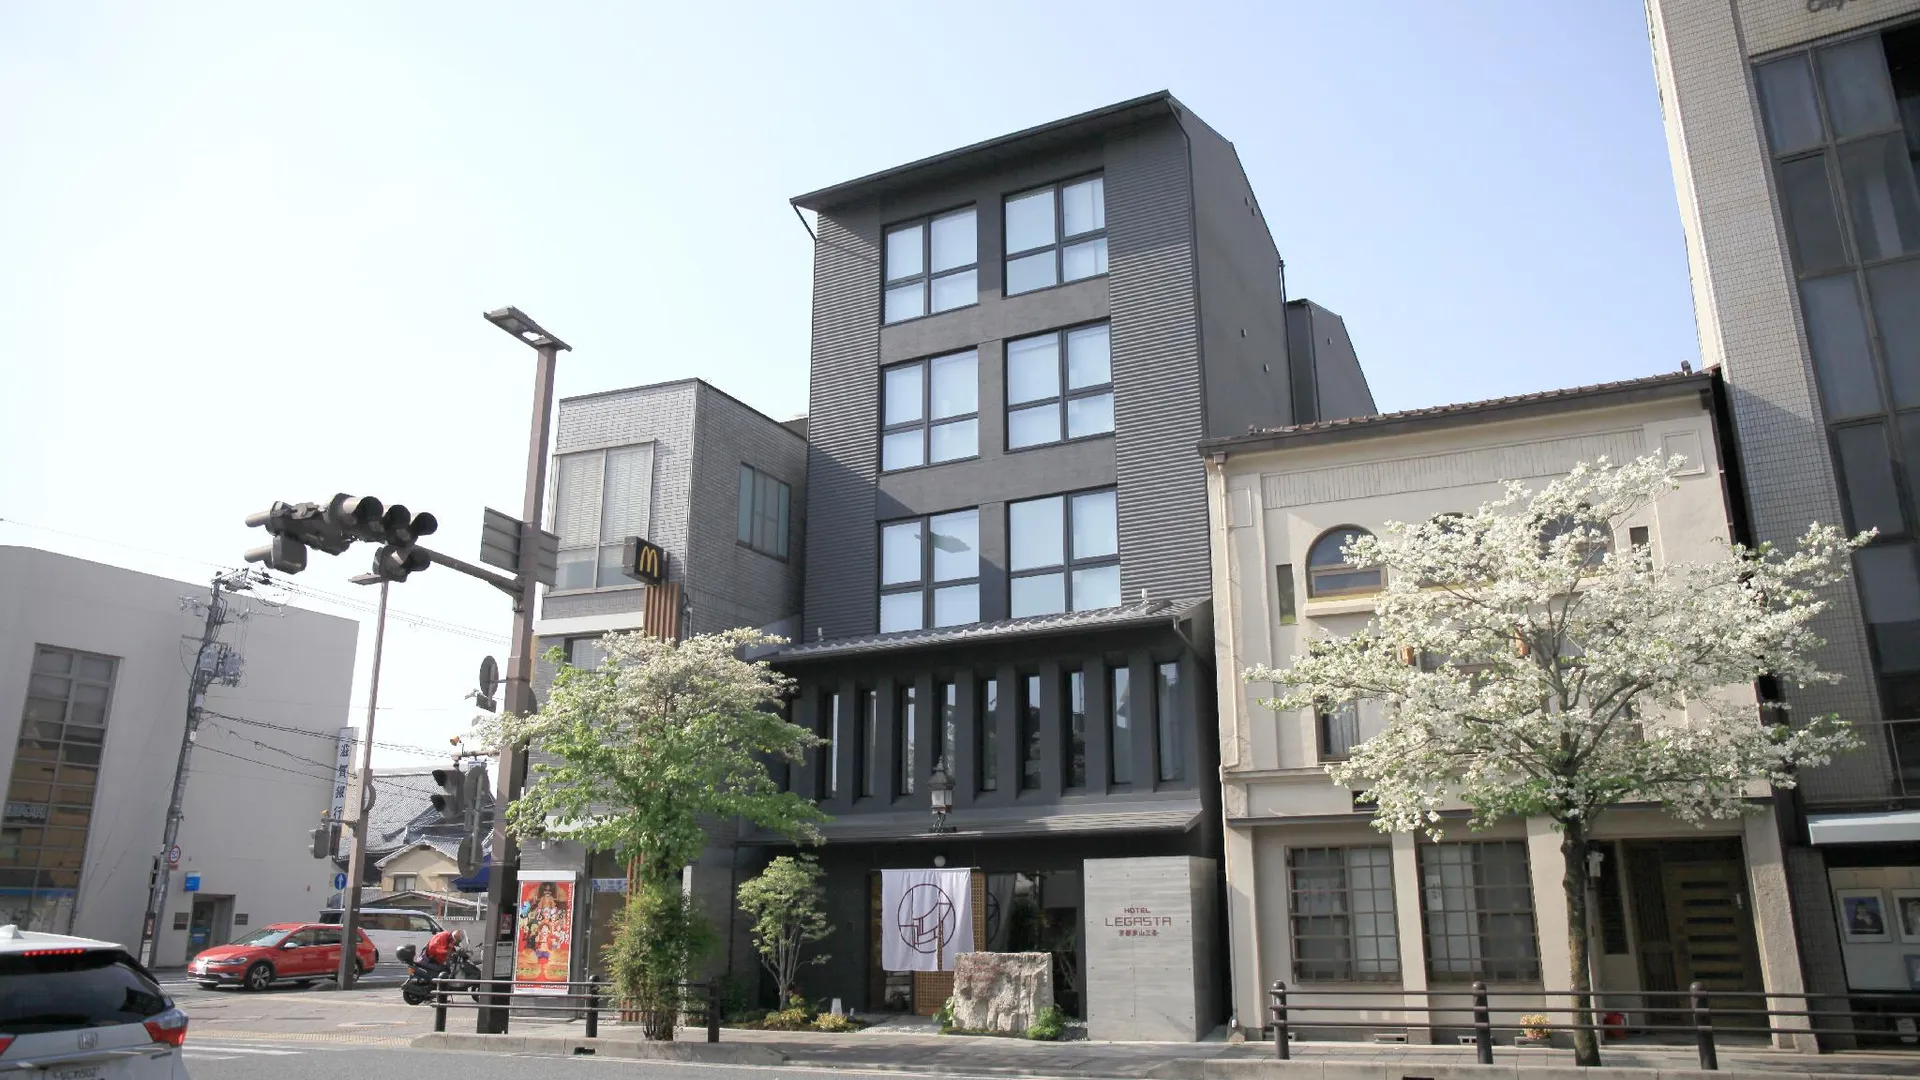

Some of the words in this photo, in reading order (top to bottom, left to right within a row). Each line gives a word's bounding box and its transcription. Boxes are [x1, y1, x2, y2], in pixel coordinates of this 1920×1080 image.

[333, 744, 350, 820] 滋賀銀行
[1105, 916, 1172, 927] LEGASTA
